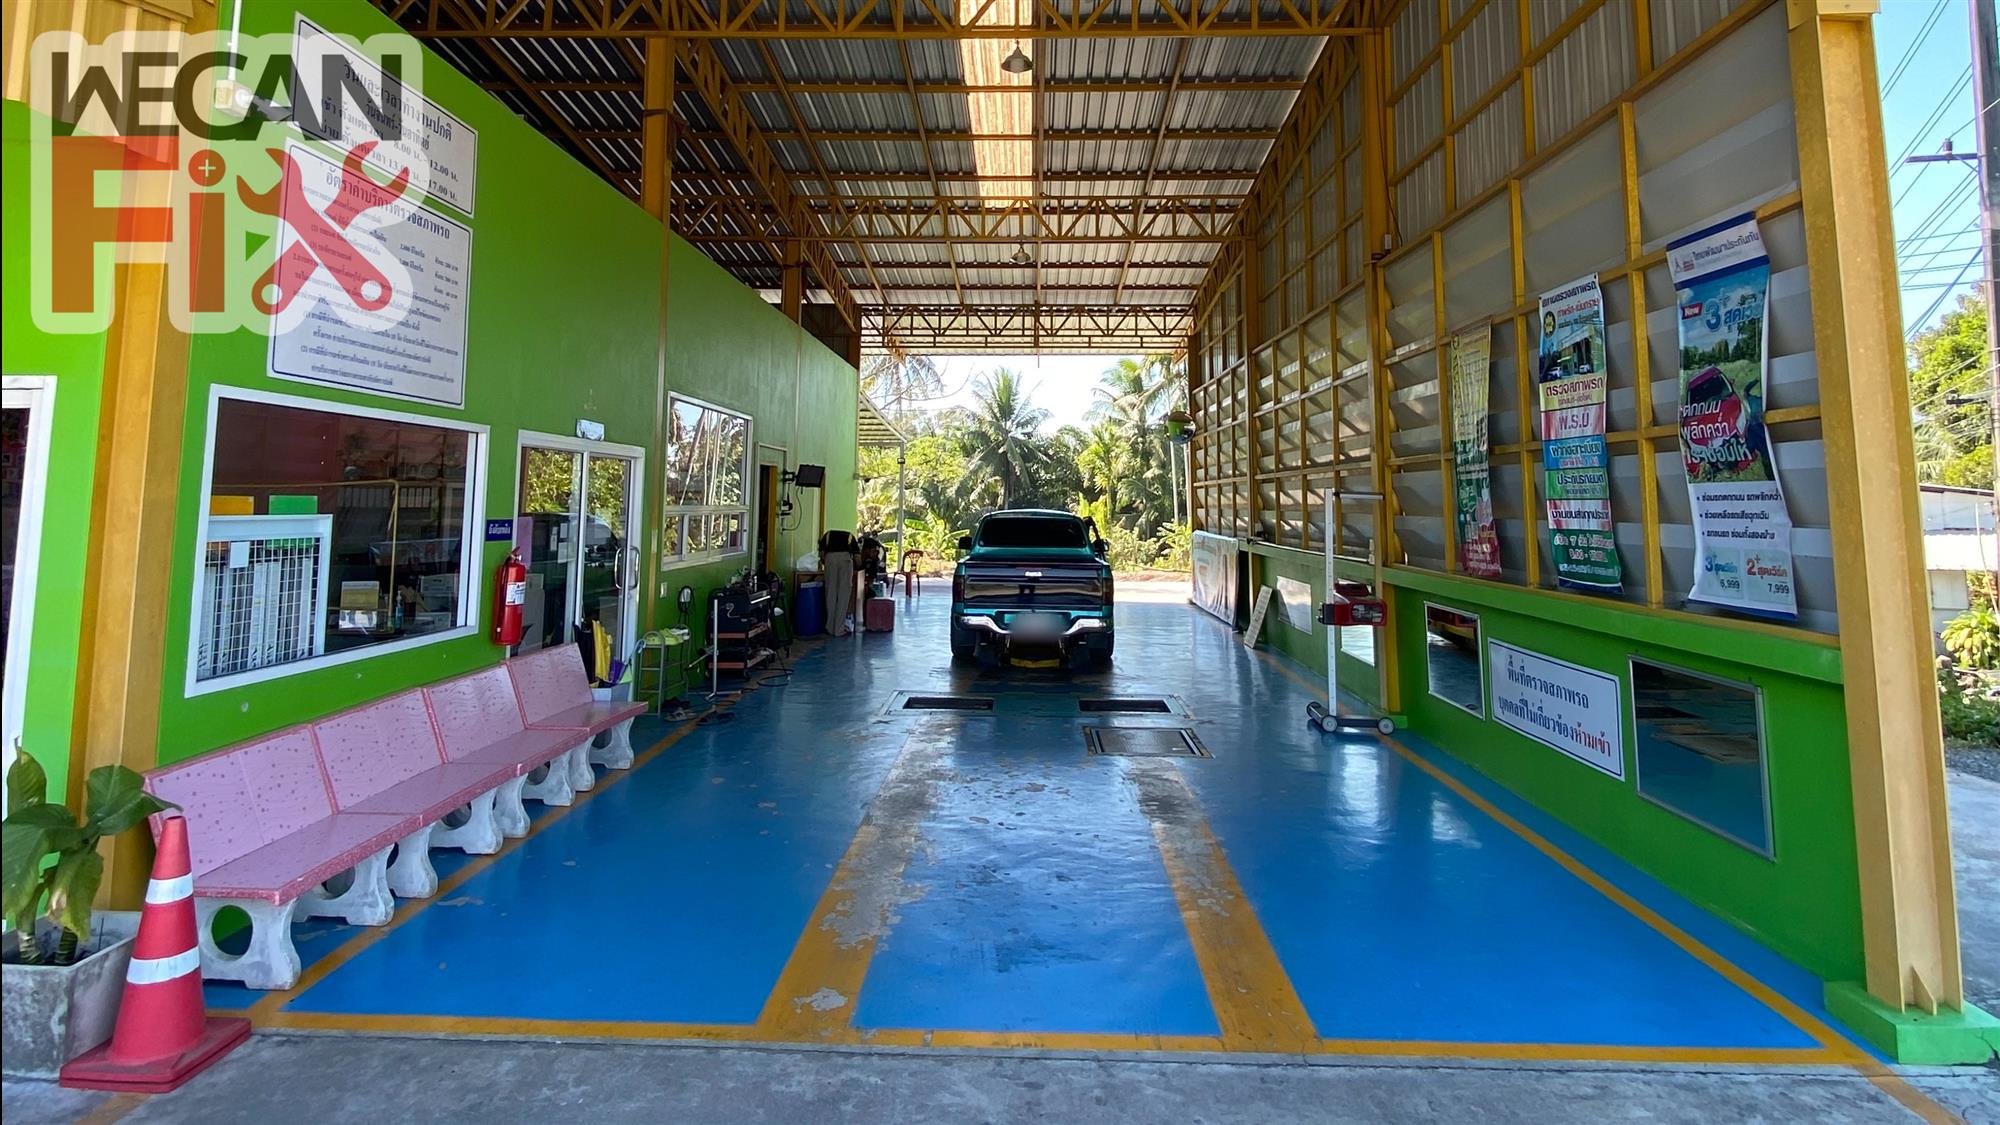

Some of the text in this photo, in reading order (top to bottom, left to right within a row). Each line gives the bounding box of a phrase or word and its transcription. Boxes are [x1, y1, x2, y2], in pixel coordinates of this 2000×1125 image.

[429, 159, 449, 177] 12.00
[428, 179, 448, 196] 17.00
[1507, 654, 1589, 709] พื้นที่ตรวจสภาพรถ
